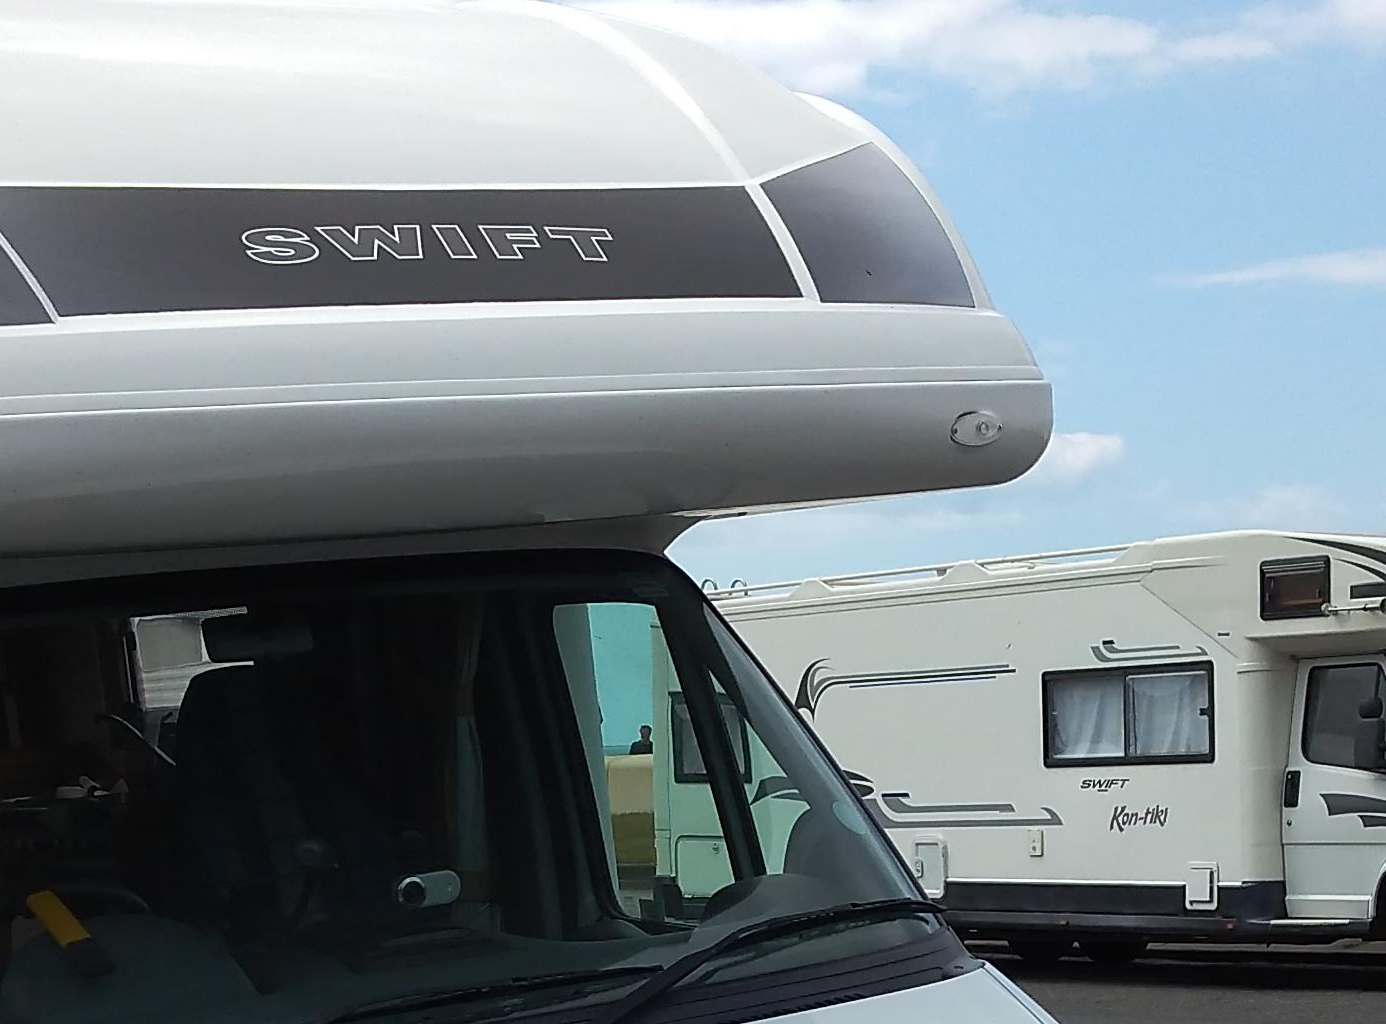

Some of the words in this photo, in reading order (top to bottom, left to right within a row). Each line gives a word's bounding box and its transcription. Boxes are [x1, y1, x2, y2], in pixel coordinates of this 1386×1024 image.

[241, 224, 614, 265] SWIFT
[1080, 778, 1130, 789] SWIFT
[1109, 804, 1168, 832] Kon-tiki
